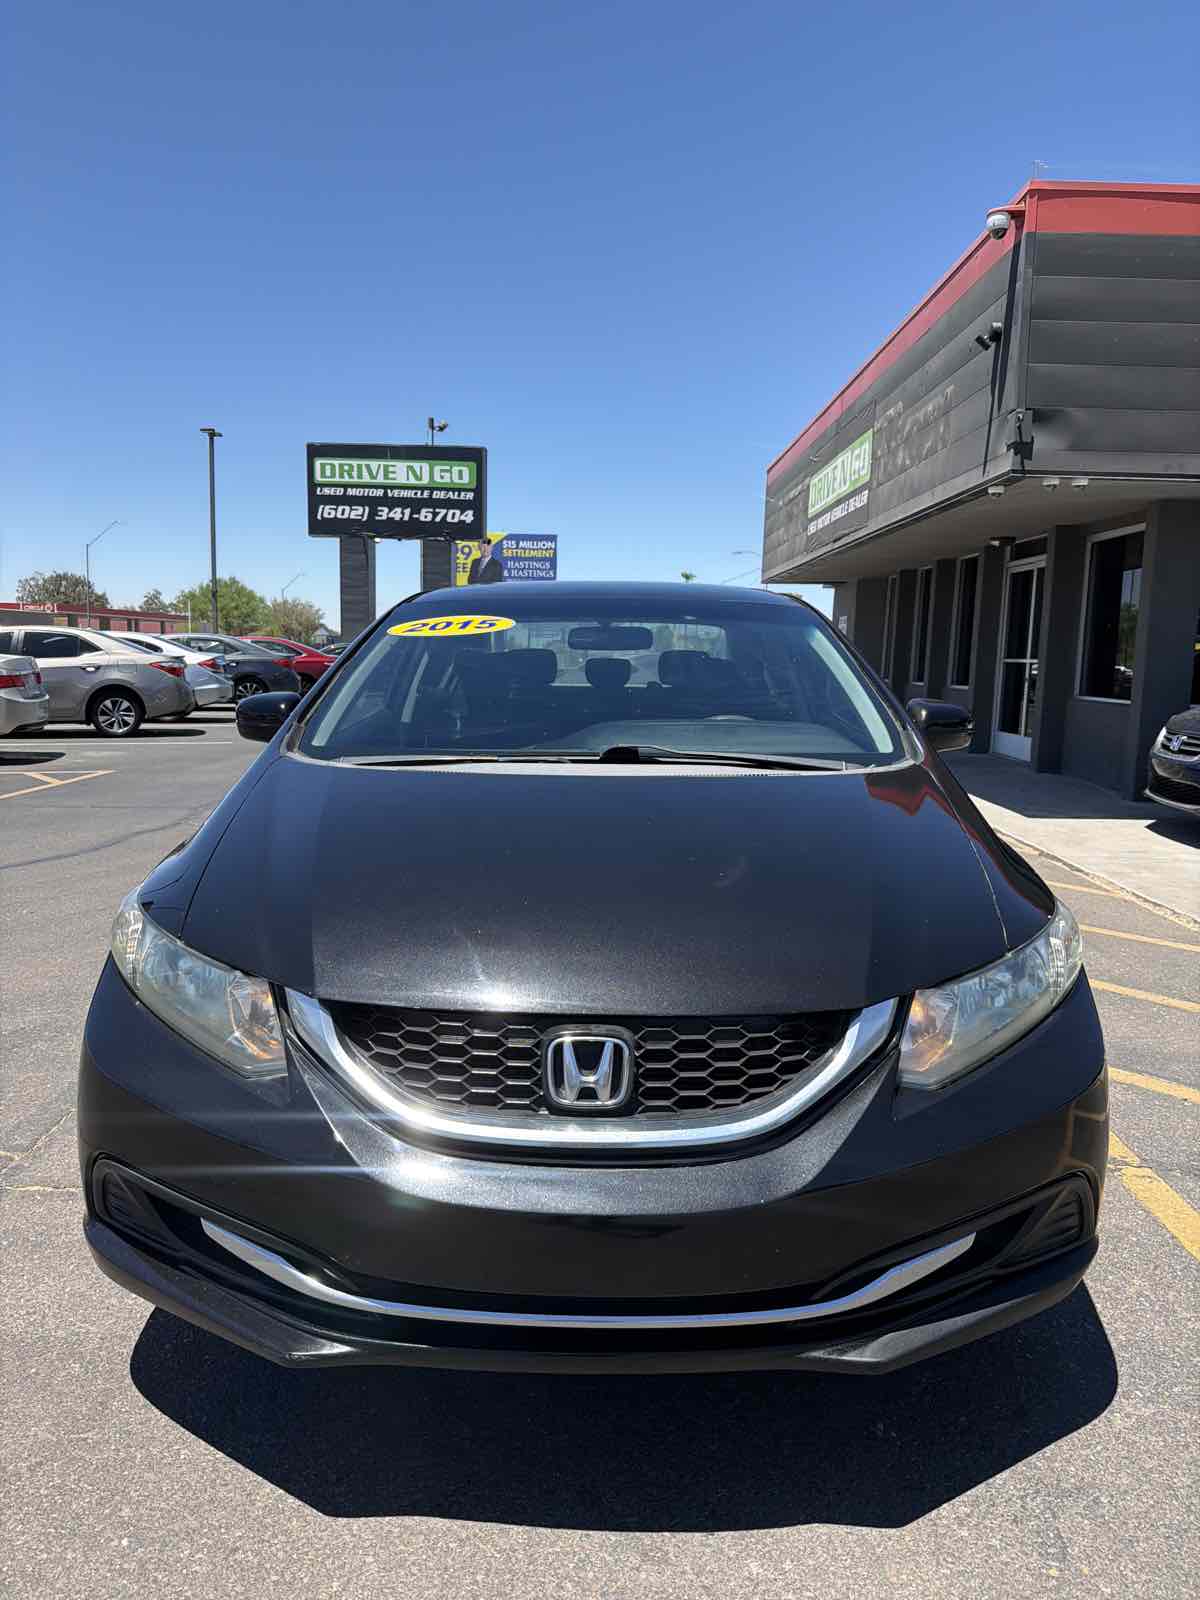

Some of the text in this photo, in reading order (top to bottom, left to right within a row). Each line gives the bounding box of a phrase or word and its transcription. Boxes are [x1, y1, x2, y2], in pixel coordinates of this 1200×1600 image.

[319, 462, 470, 484] DRIVE N GO
[316, 487, 474, 500] USED MOTOR VEHICLE DEALER
[316, 504, 474, 523] (602) 341-6704
[503, 540, 555, 549] $15 MILLION
[503, 549, 555, 558] SETTLEMENT
[507, 560, 551, 569] HASTINGS
[503, 569, 554, 577] & HASTINGS
[402, 620, 497, 633] 2015
